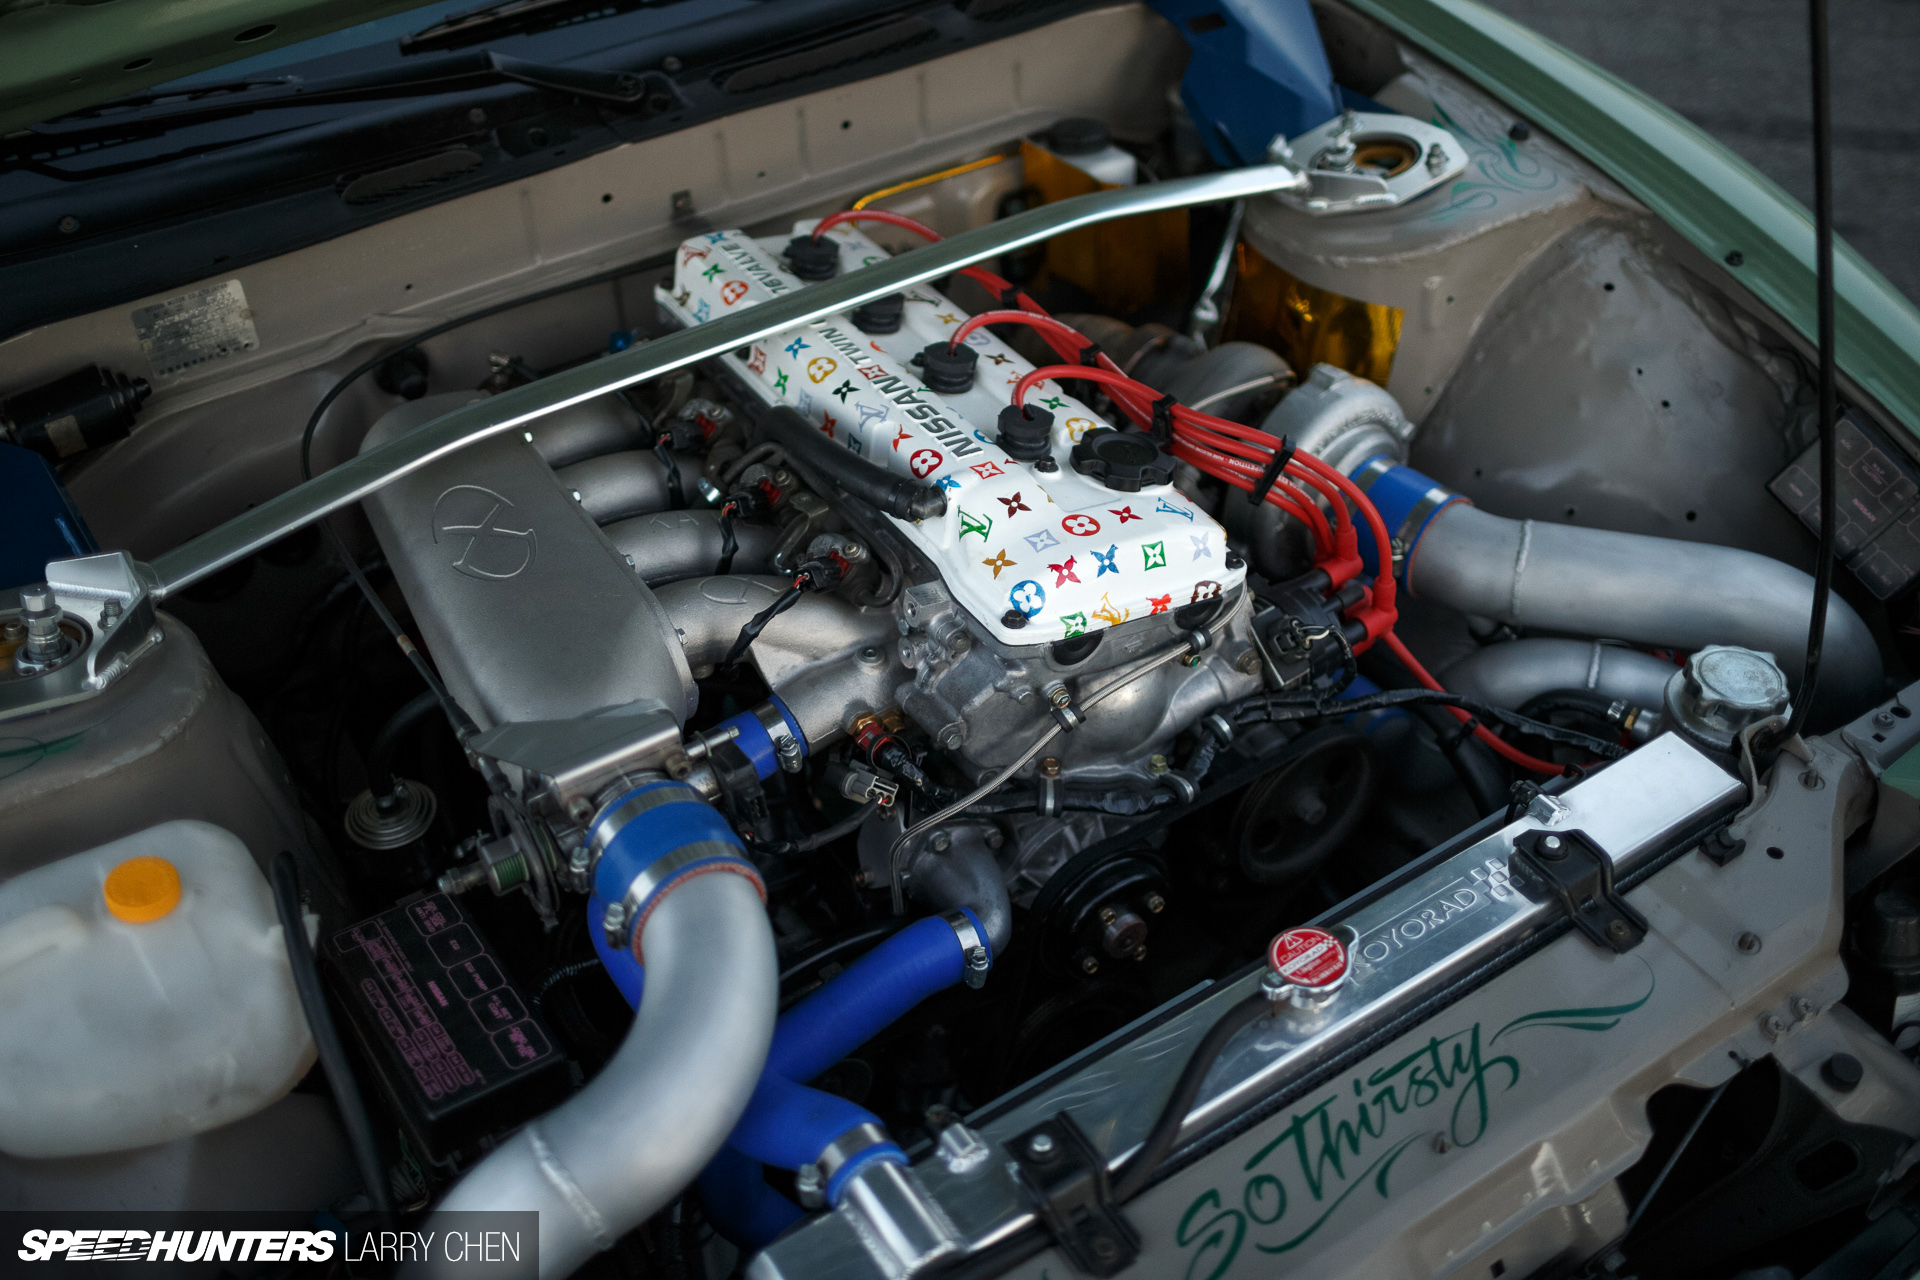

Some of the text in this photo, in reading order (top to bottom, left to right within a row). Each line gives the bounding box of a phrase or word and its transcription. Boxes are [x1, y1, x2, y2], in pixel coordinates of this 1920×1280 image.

[721, 242, 790, 295] 16VALVE
[818, 326, 984, 459] NISSAN TWIN
[1352, 888, 1478, 974] KOYORAD
[1280, 935, 1323, 963] CAUTION
[1282, 945, 1325, 974] KOYORAD
[426, 978, 449, 1008] NISSAN
[472, 971, 488, 993] PUMP
